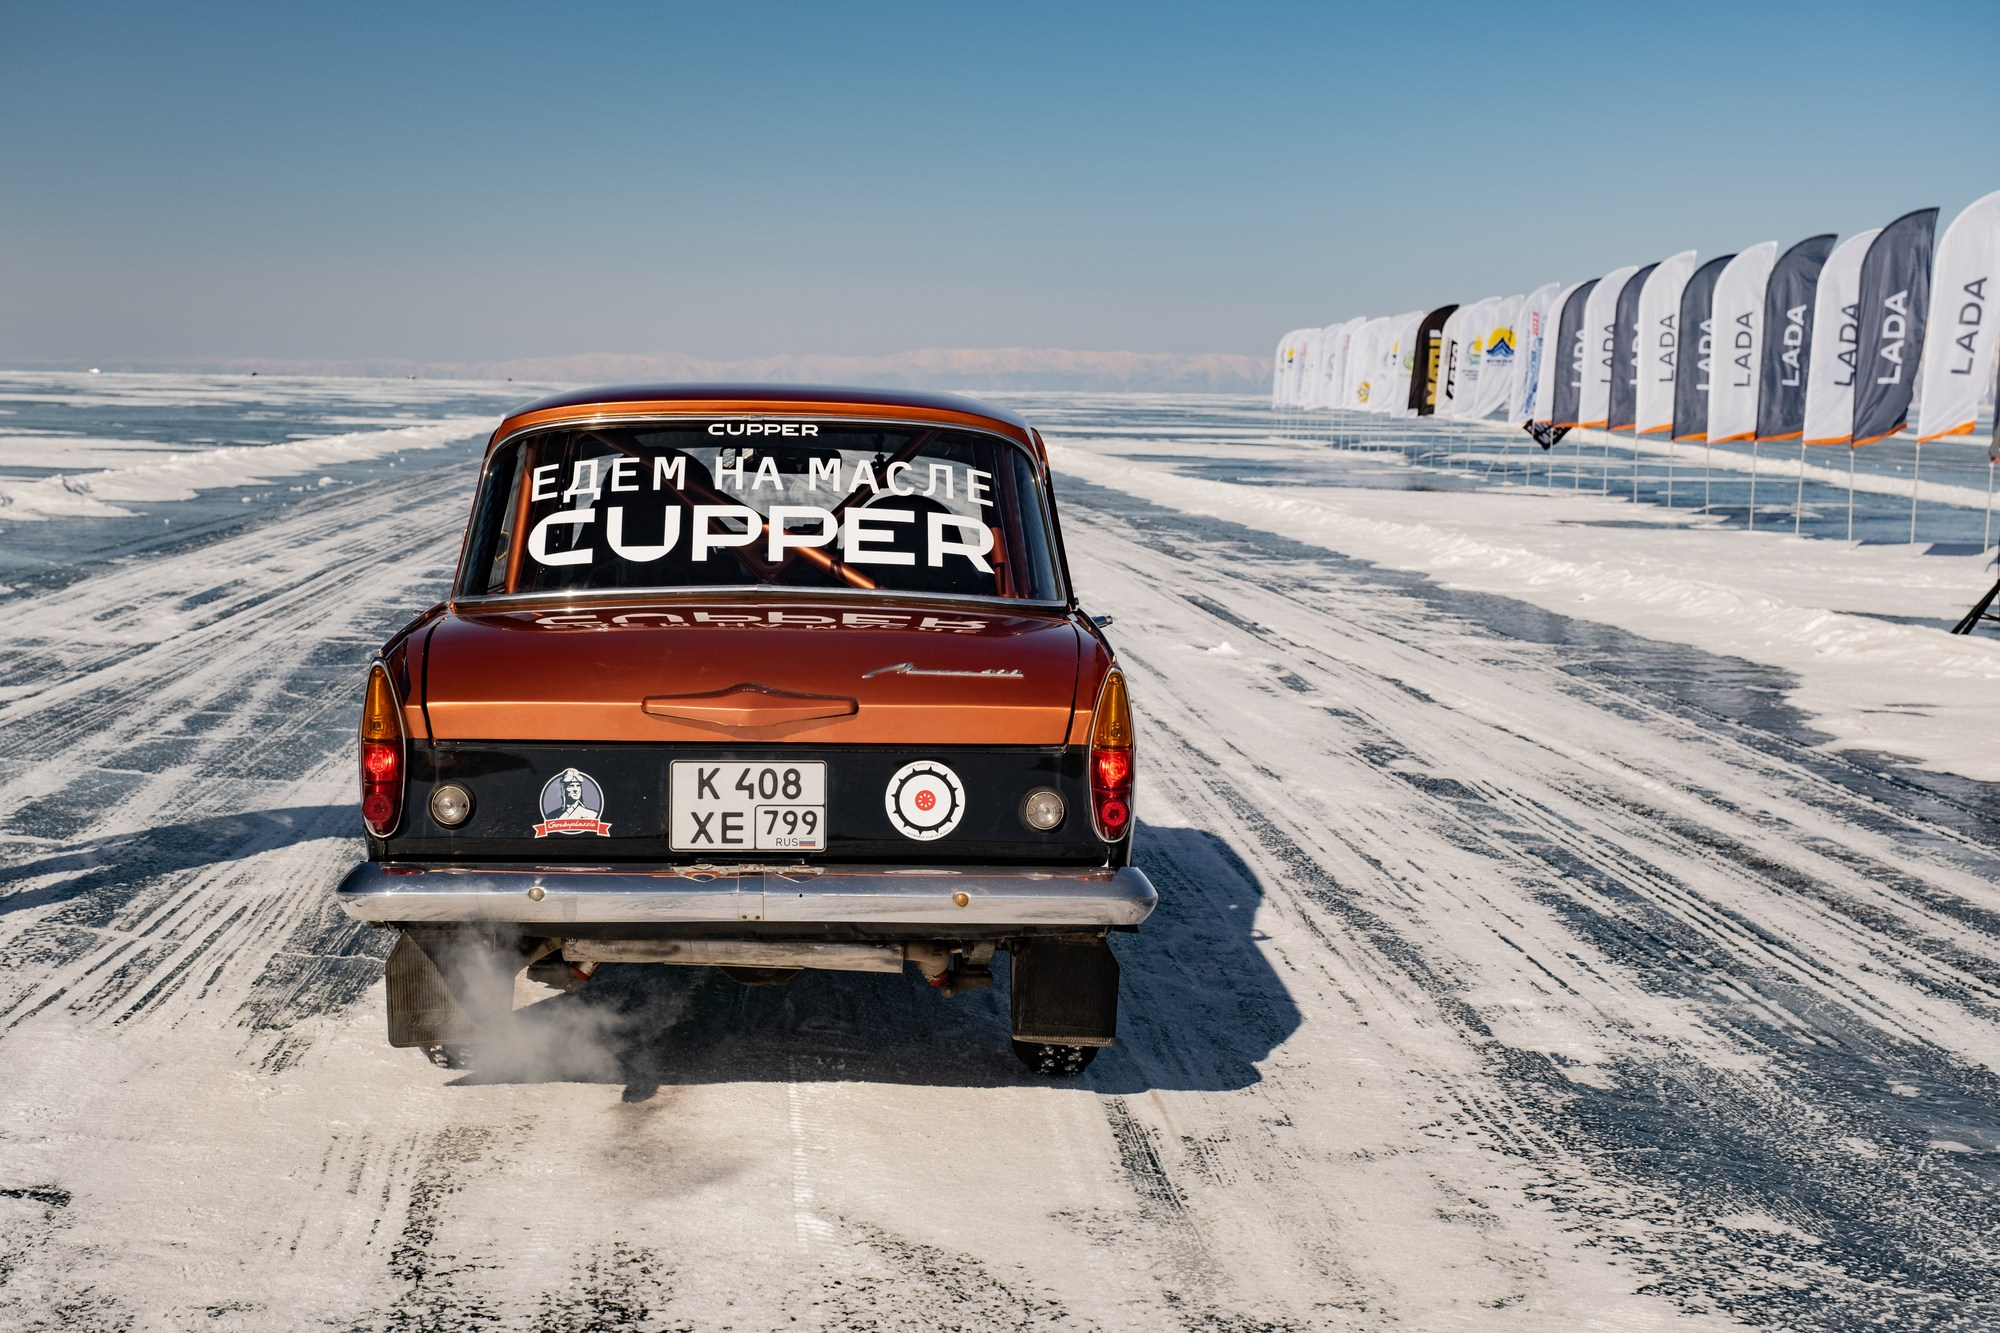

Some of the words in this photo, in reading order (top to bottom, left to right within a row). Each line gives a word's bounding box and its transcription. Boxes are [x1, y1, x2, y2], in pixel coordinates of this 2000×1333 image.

[1659, 314, 1675, 382] LADA
[1696, 319, 1712, 390] LADA
[1734, 311, 1753, 387] LADA
[1781, 304, 1807, 387] LADA
[1834, 303, 1860, 386] LADA
[1877, 290, 1908, 385] LADA
[1951, 276, 1987, 375] LADA
[708, 423, 818, 437] CUPPER
[531, 456, 685, 502] ЕДЕМ
[714, 455, 784, 491] НА
[809, 456, 994, 507] МАСЛЕ
[527, 505, 995, 574] CUPPER
[735, 767, 802, 800] 408
[763, 810, 818, 836] 799
[776, 837, 799, 847] RUS
